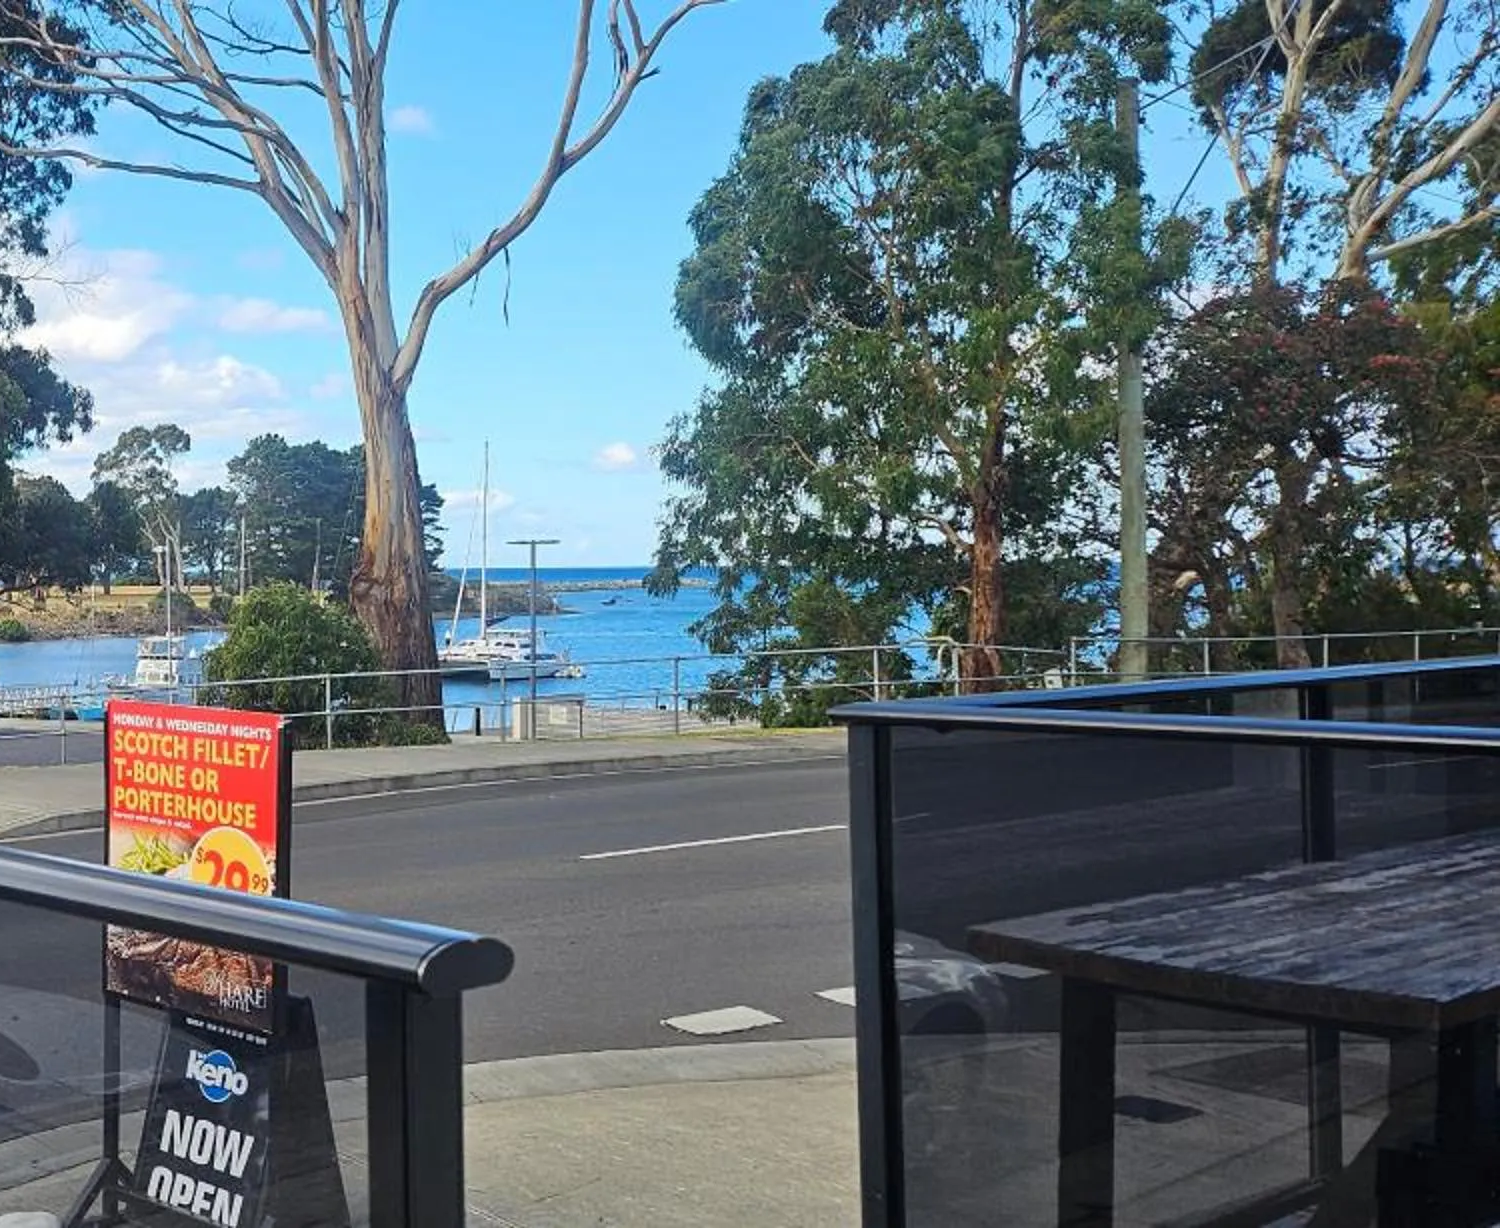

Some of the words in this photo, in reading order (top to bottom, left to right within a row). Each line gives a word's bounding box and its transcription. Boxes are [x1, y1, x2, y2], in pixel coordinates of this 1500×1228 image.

[112, 713, 155, 727] MONDAY
[165, 719, 229, 737] WEDNESDAY
[231, 725, 272, 741] NIGHTS
[114, 729, 188, 761] SCOTCH
[193, 737, 270, 769] FILLET/
[113, 756, 186, 790] T-BONE
[191, 767, 220, 794] OR
[114, 785, 258, 829] PORTERHOUSE
[159, 1109, 254, 1179] NOW
[147, 1165, 244, 1228] OPEN
